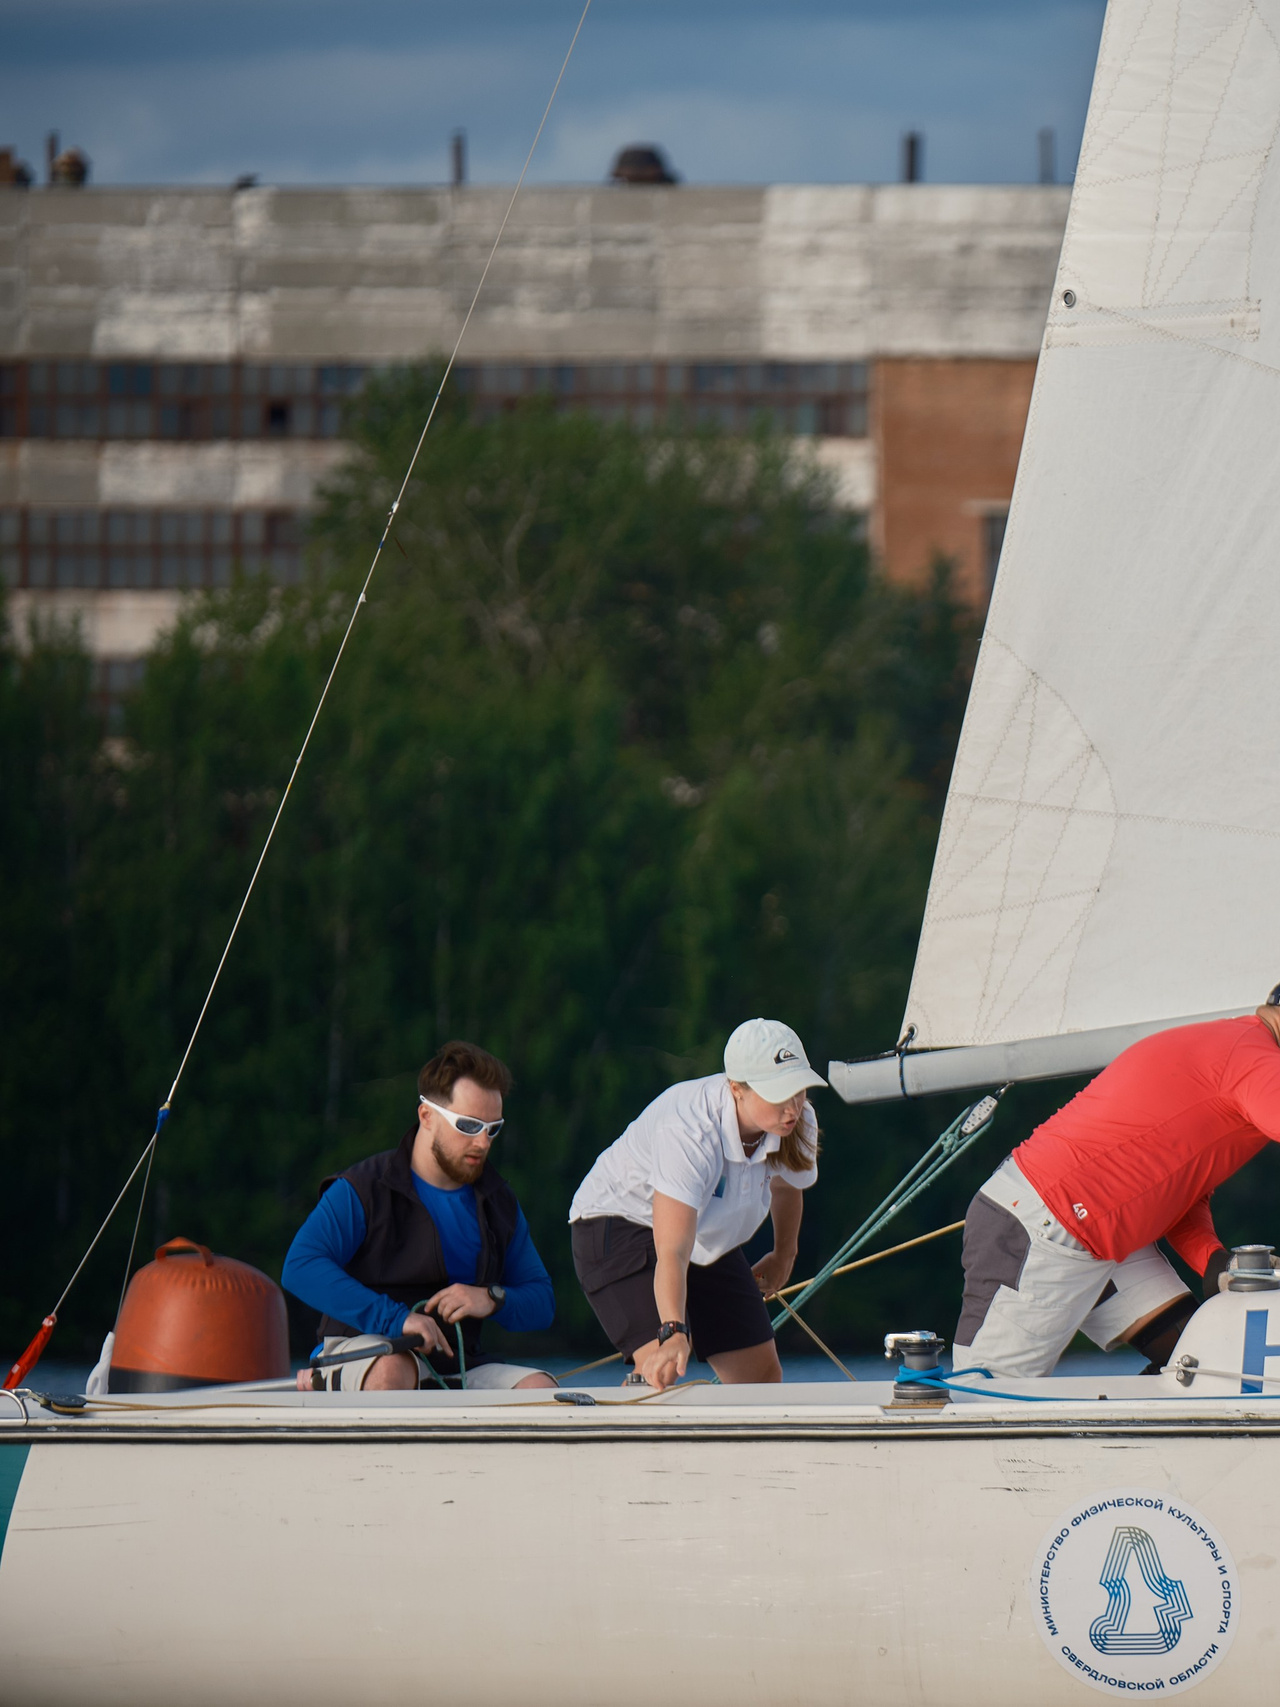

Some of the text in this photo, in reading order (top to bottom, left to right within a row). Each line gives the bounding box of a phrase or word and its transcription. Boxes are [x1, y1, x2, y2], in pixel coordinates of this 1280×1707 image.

[1039, 1497, 1231, 1636] МИНИСТЕРСТВО ФИЗИЧЕСКОЙ КУЛЬТУРЫ И СПОРТА
[1061, 1643, 1219, 1691] СВЕРДЛОВСКОЙ ОБЛАСТИ
